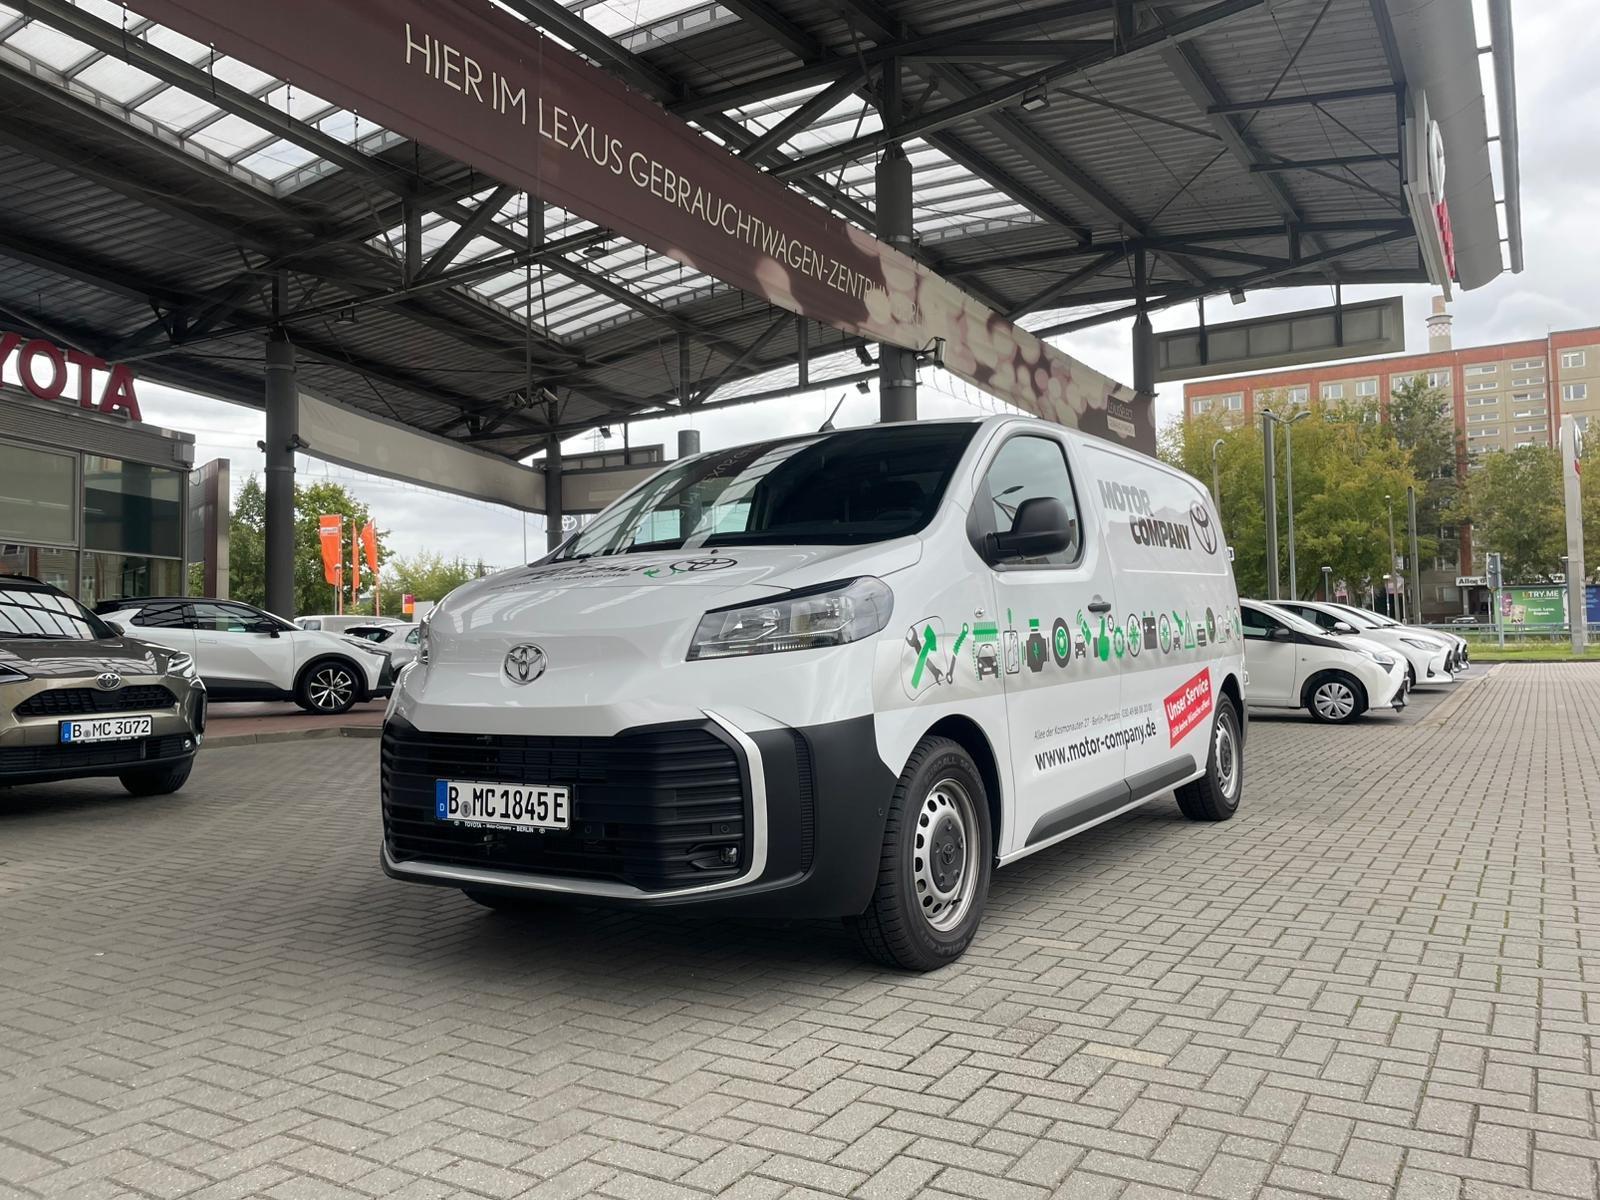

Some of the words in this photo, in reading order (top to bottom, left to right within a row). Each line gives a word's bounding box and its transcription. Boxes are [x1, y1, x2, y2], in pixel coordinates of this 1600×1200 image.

[406, 23, 483, 103] HIER
[493, 72, 525, 125] IM
[539, 98, 623, 175] LEXUS
[1097, 480, 1154, 517] MOTOR
[1129, 515, 1191, 550] COMPANY
[1167, 696, 1187, 720] Unser
[1186, 678, 1209, 705] Service
[73, 724, 81, 738] B
[93, 722, 111, 737] MC
[115, 720, 149, 735] 3072
[1035, 717, 1157, 771] www.motor-company.de
[449, 786, 459, 814] B
[464, 821, 482, 829] TOYOTA
[516, 825, 534, 833] BERLIN
